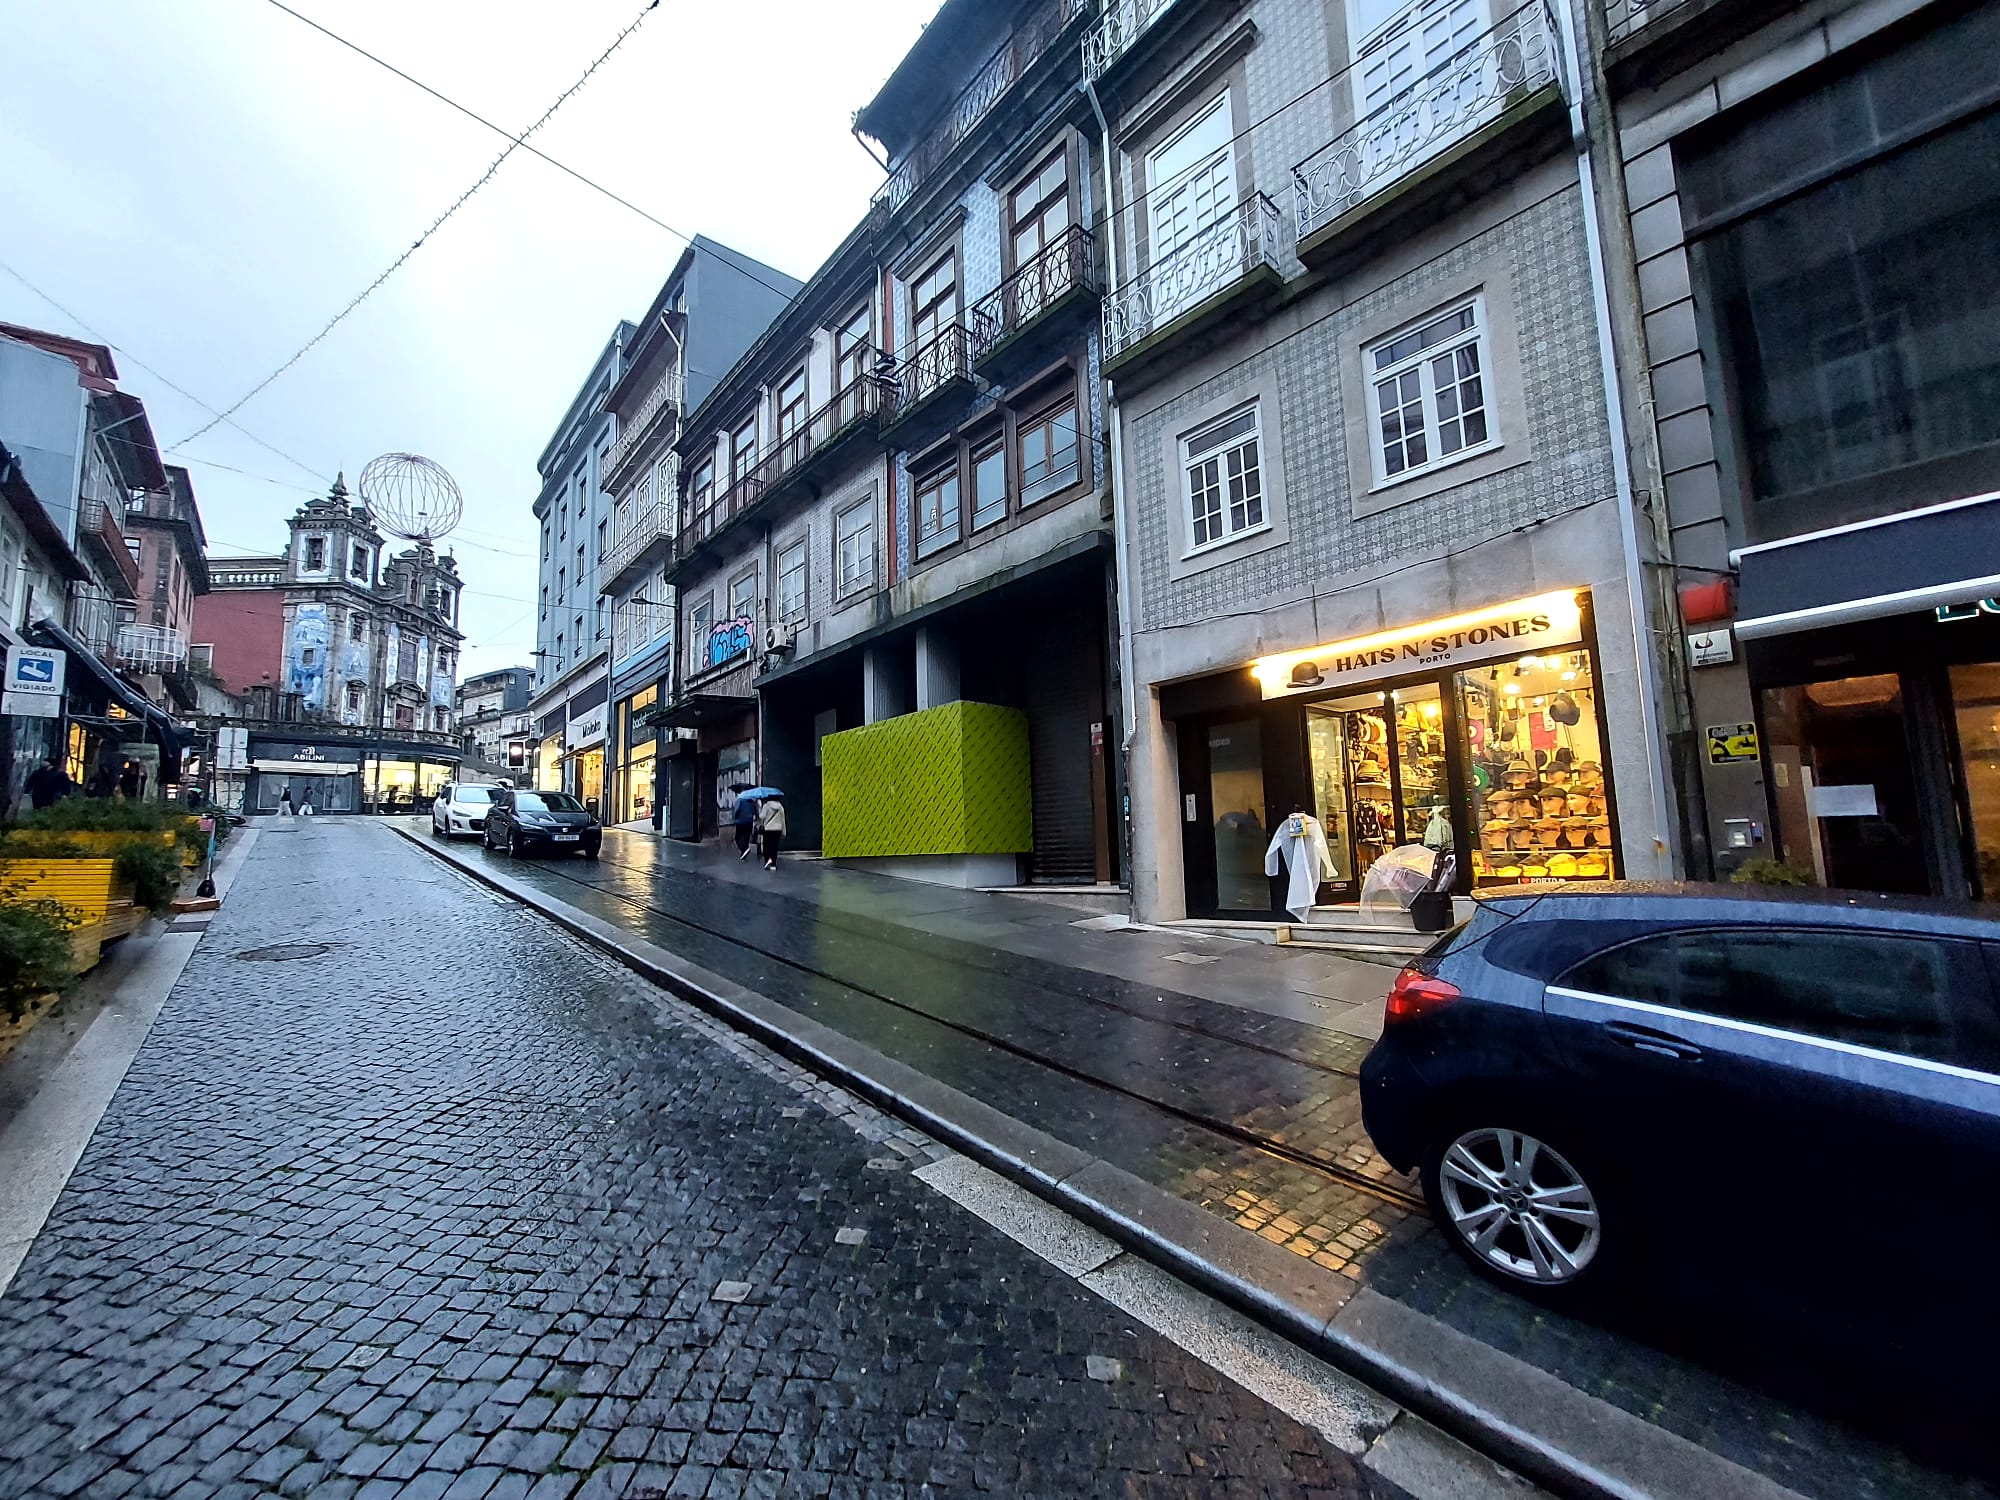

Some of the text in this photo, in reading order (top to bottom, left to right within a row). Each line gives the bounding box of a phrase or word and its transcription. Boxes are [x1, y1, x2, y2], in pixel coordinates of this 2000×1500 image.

[1336, 647, 1396, 673] HATS
[1431, 615, 1551, 653] STONES
[20, 649, 54, 658] LOCAL
[1419, 653, 1451, 665] PORTO
[12, 682, 56, 692] VIGIADO
